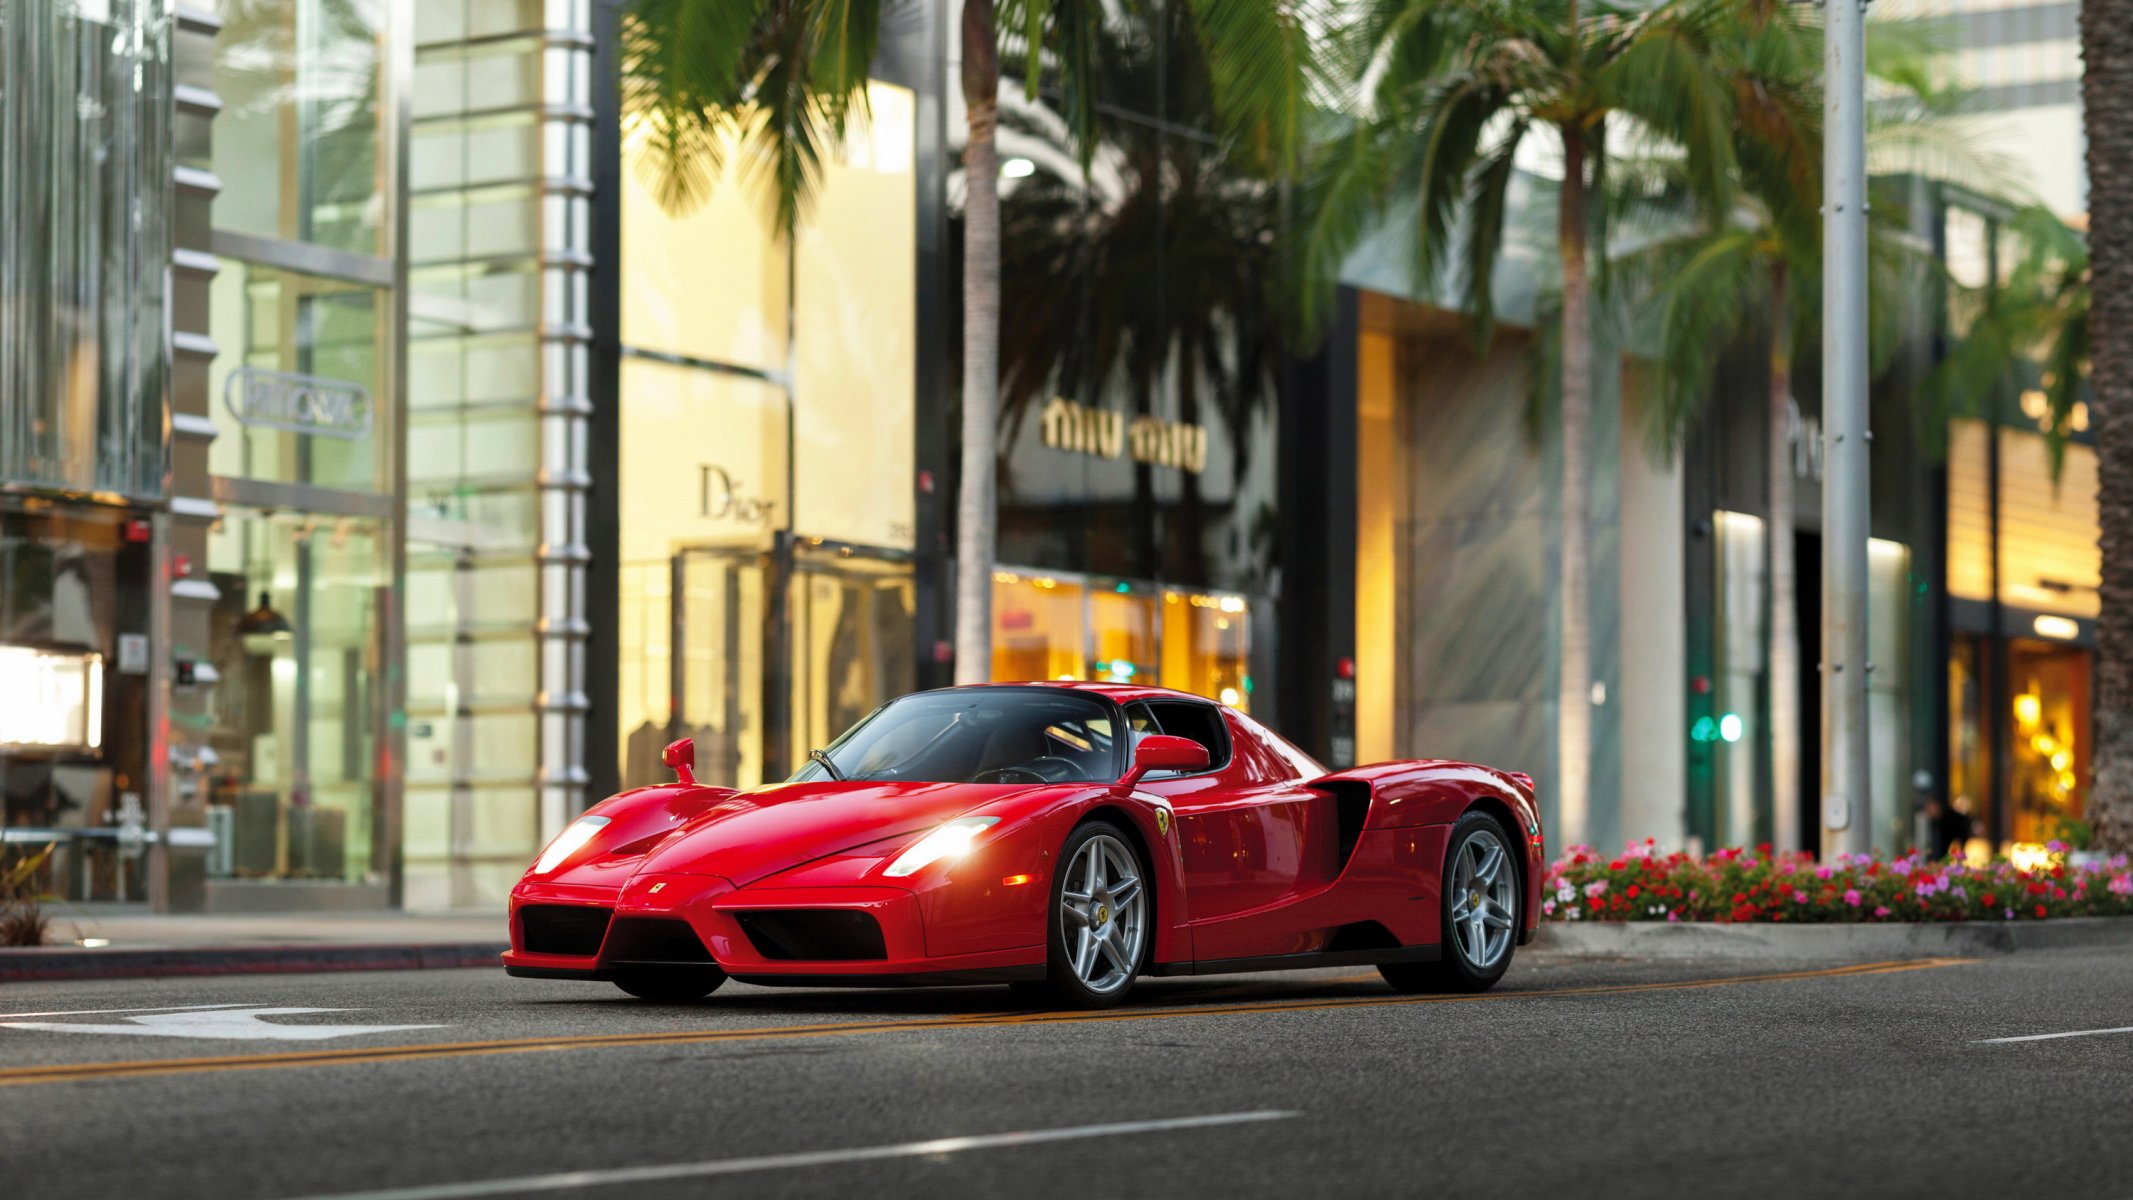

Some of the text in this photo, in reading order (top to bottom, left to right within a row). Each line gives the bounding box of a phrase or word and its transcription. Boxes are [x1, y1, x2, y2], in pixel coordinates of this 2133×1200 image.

[1041, 395, 1208, 475] miu miu
[697, 463, 776, 523] Dior
